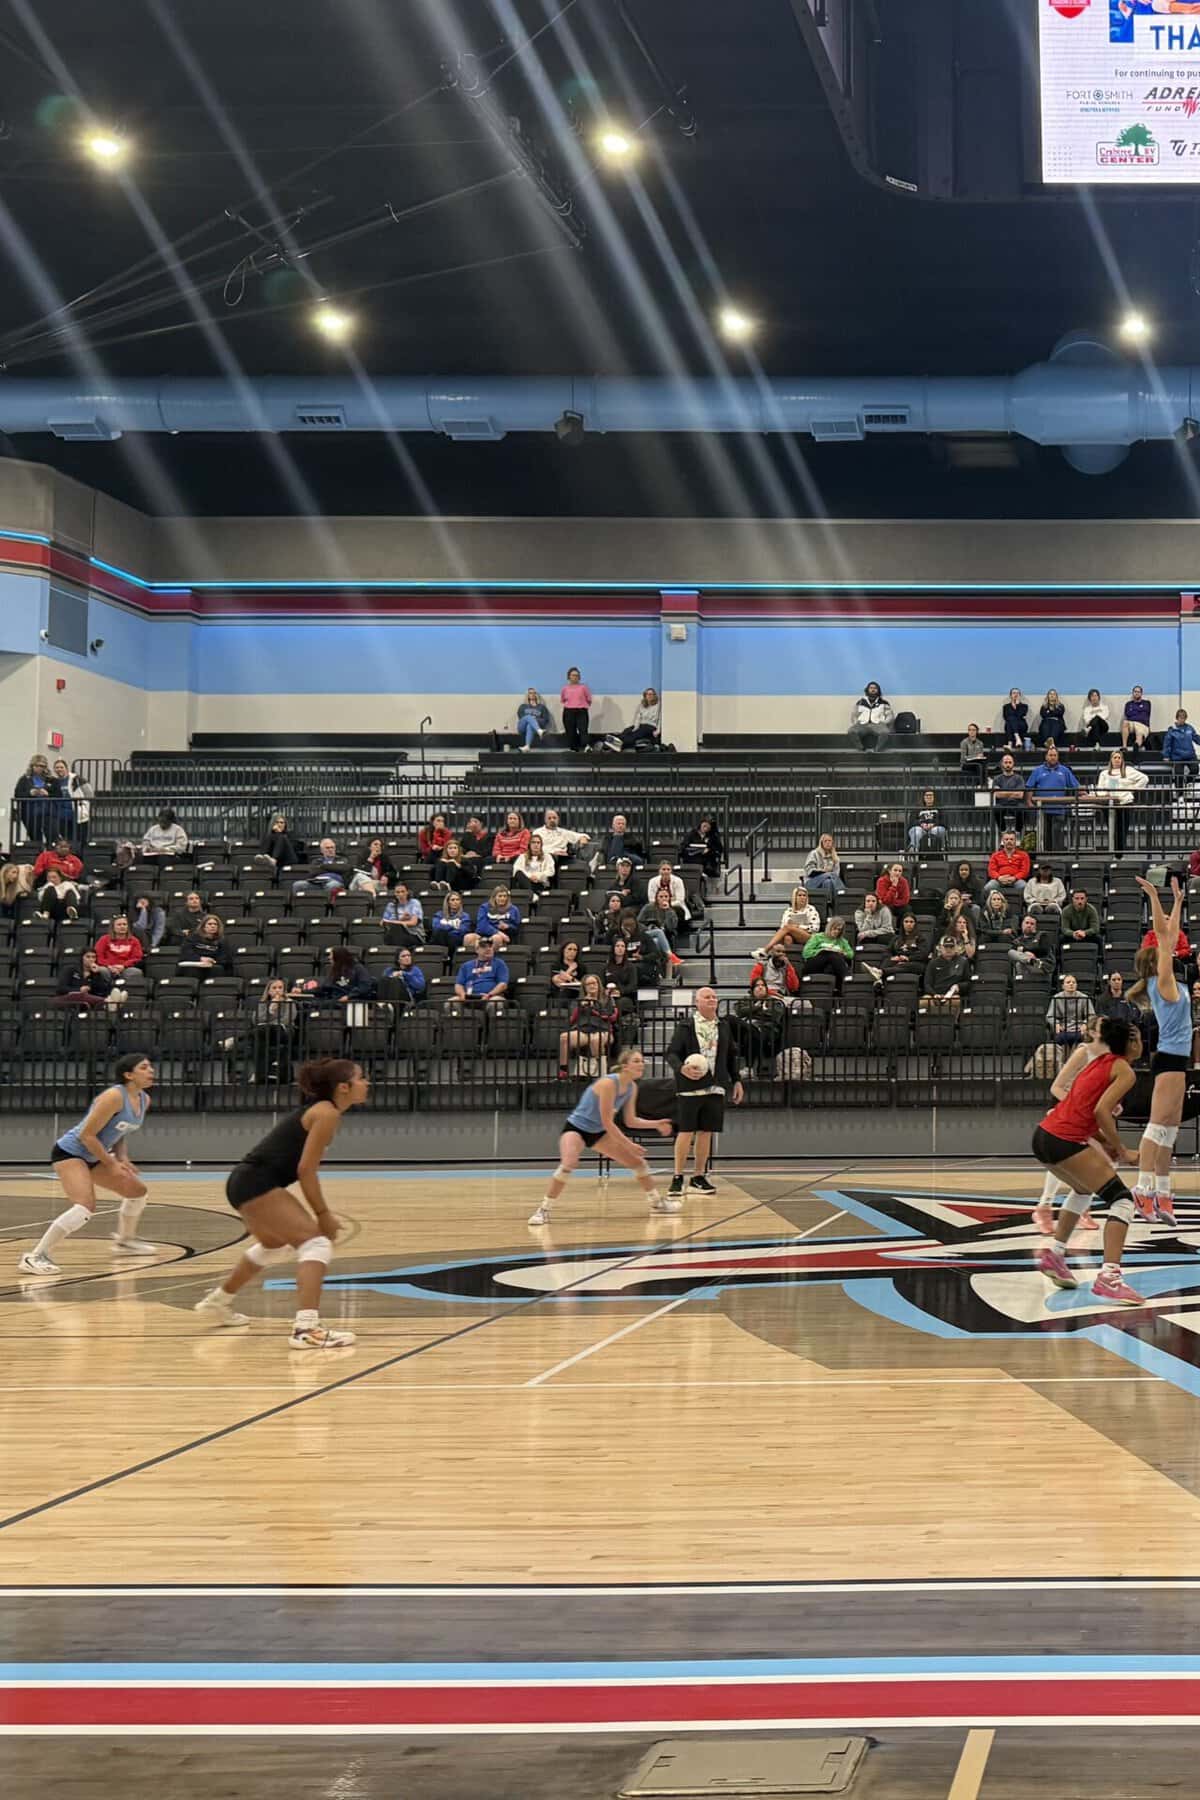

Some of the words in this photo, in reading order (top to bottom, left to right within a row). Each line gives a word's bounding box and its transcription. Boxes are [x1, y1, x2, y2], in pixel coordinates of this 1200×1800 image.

[1114, 69, 1128, 77] For
[1130, 69, 1174, 79] continuing
[1066, 90, 1091, 100] FORT
[1104, 90, 1133, 100] SMITH
